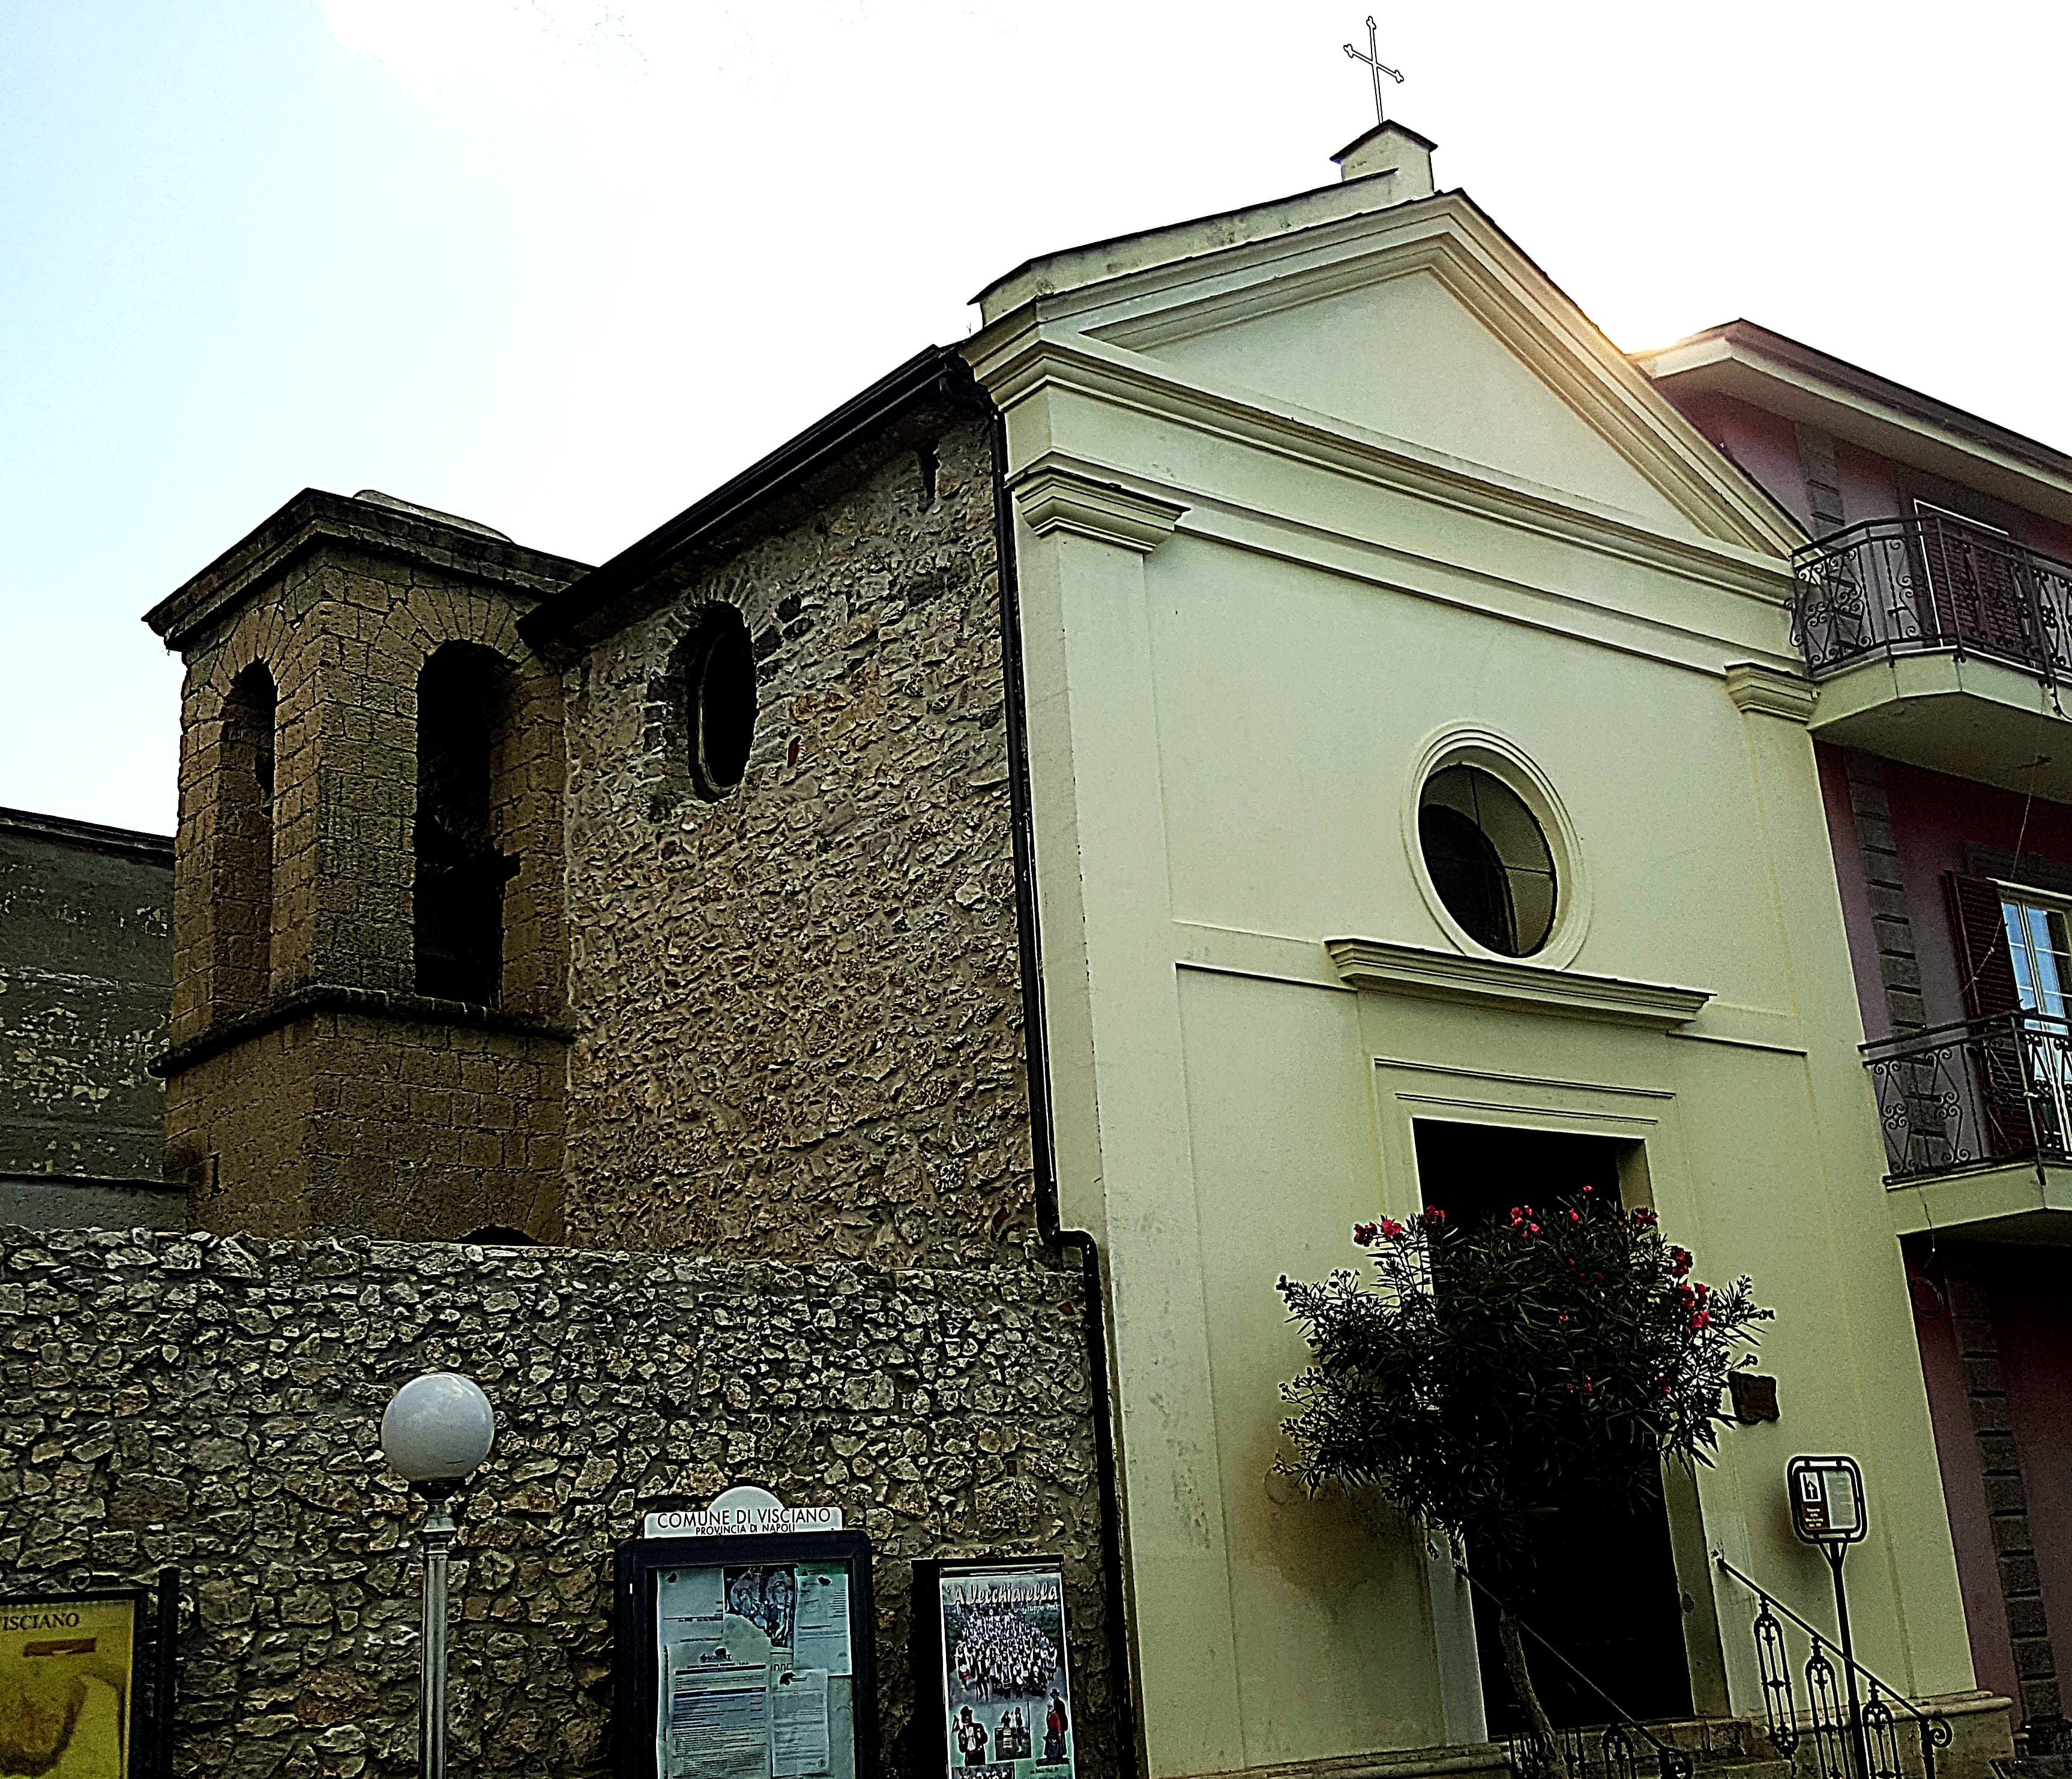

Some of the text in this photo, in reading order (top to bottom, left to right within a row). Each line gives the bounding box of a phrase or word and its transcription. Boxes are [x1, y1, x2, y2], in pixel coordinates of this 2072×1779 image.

[657, 1508, 831, 1529] COMUNE DI VISCIANO
[696, 1525, 746, 1535] PROVINCIA
[762, 1523, 795, 1532] NAPOLI
[0, 1613, 79, 1631] ISCIANO
